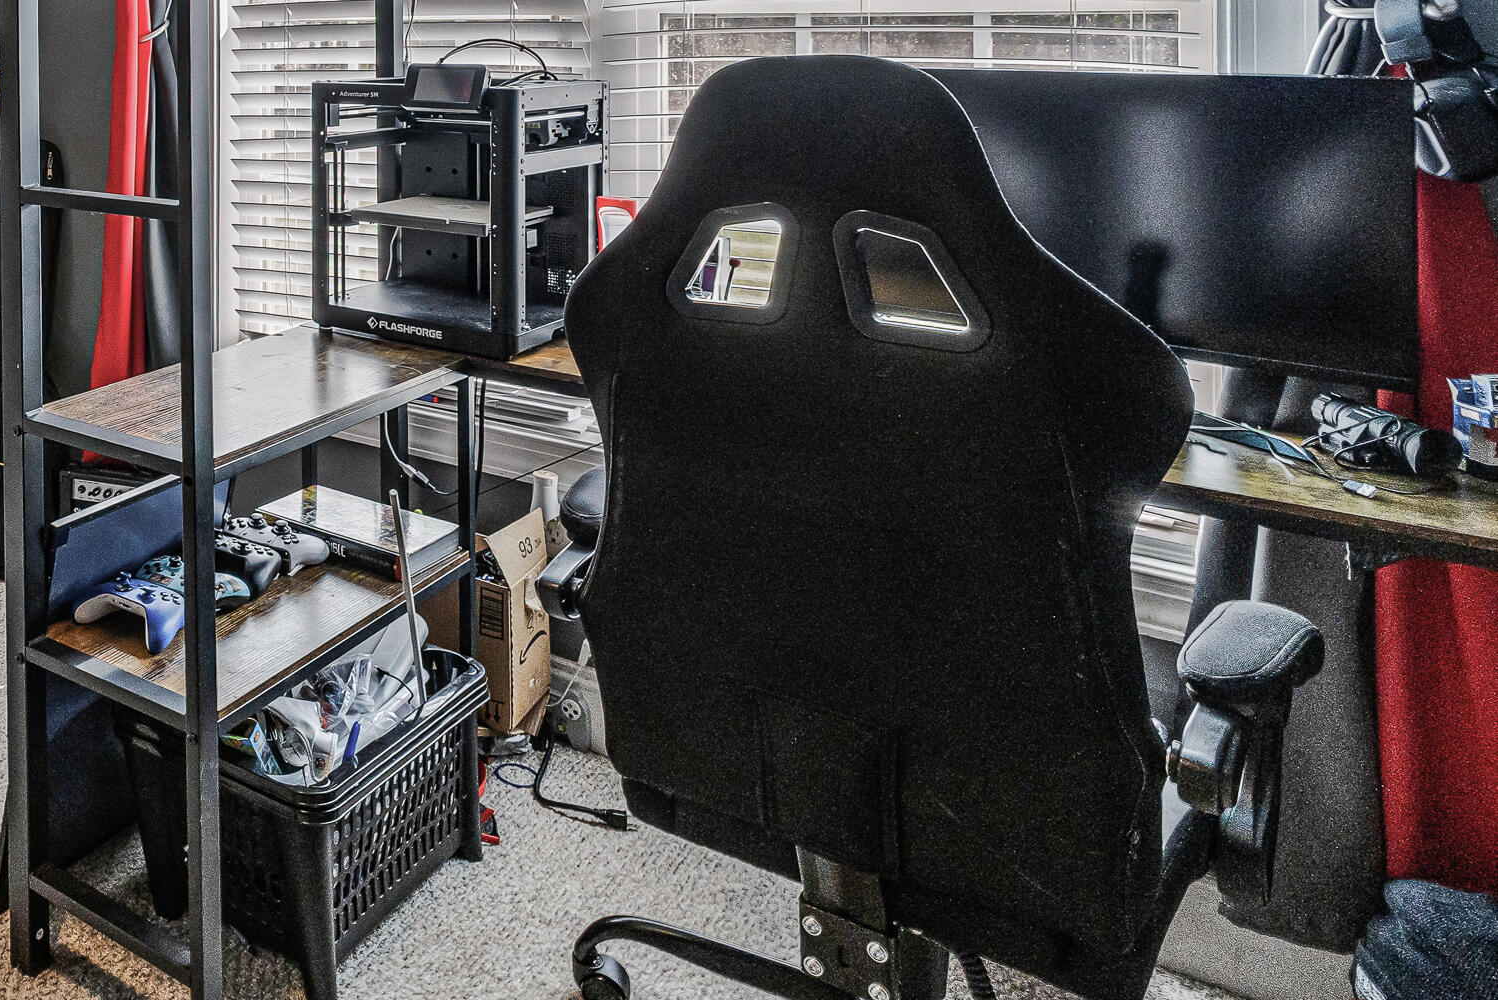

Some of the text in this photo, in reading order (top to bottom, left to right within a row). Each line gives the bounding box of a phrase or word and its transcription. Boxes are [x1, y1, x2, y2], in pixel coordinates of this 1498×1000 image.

[339, 90, 370, 98] Adventurer
[379, 320, 443, 340] FLASHFORGE
[518, 537, 533, 558] 93
